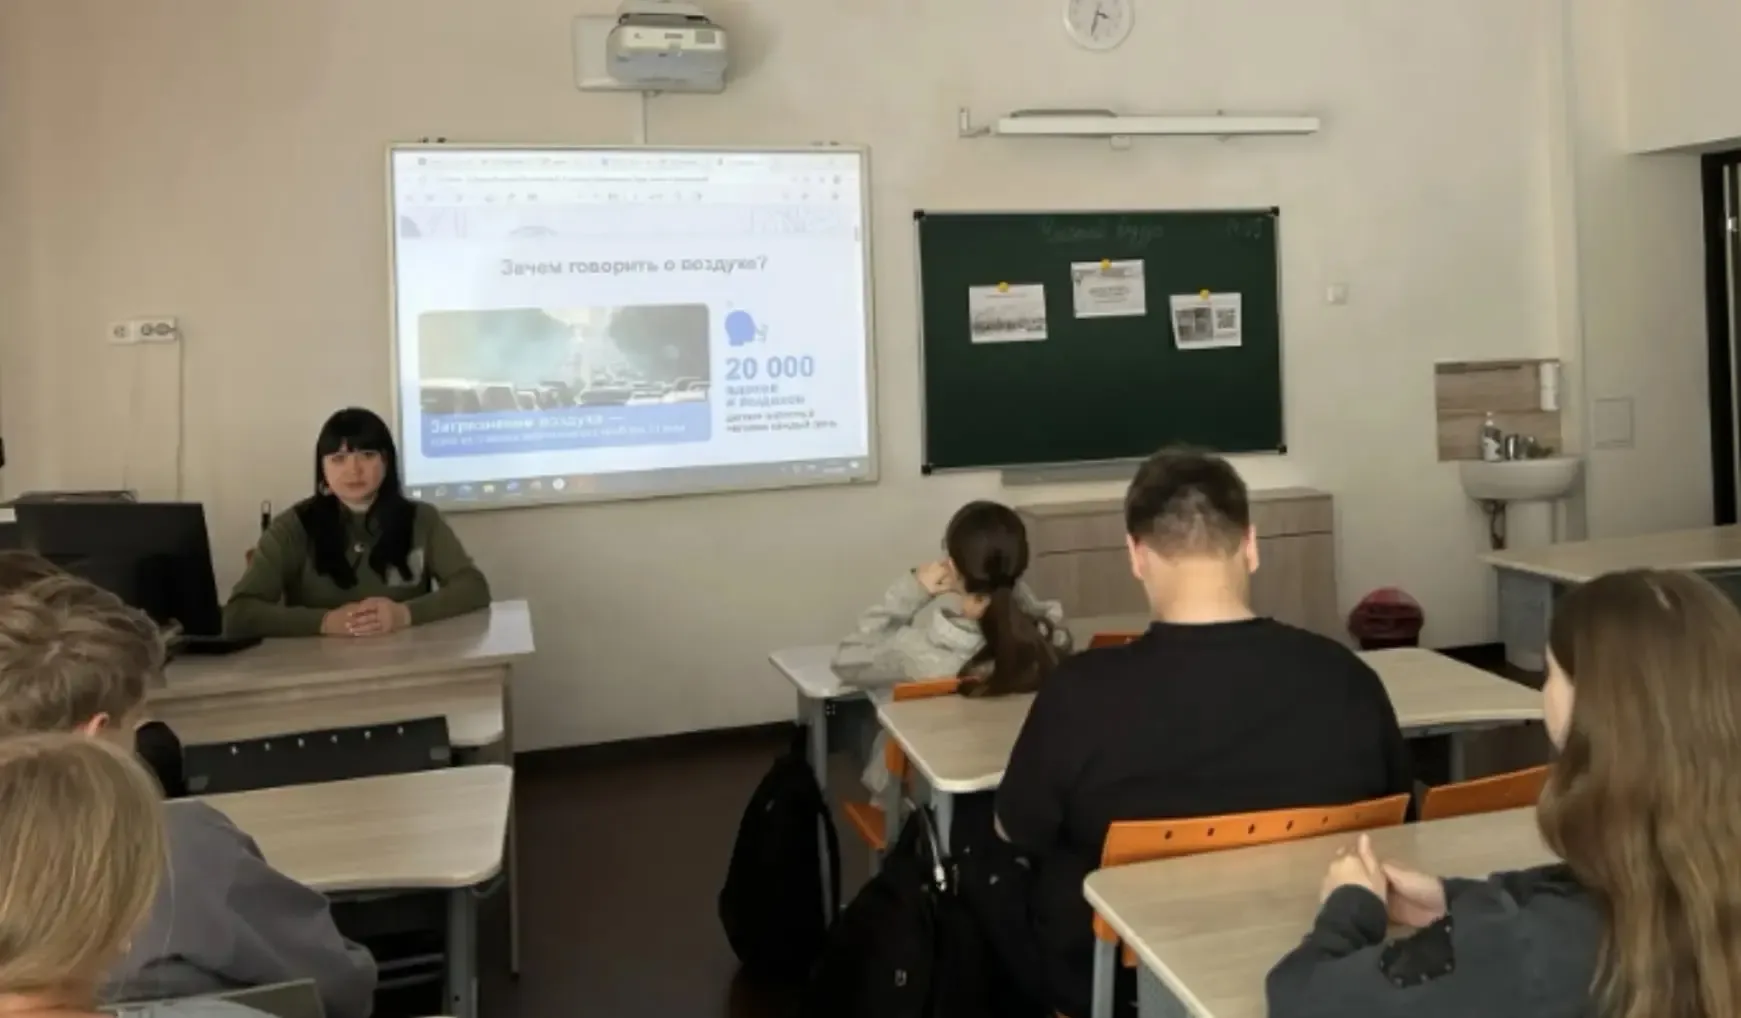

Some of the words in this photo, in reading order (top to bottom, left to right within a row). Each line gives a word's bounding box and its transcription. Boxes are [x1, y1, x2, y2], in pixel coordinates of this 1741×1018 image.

[500, 258, 562, 276] Зачем
[568, 259, 659, 277] говорить
[664, 259, 676, 272] о
[682, 254, 769, 277] воздухе?
[725, 357, 758, 380] 20
[766, 354, 815, 378] 000
[430, 418, 534, 436] Загрязнение
